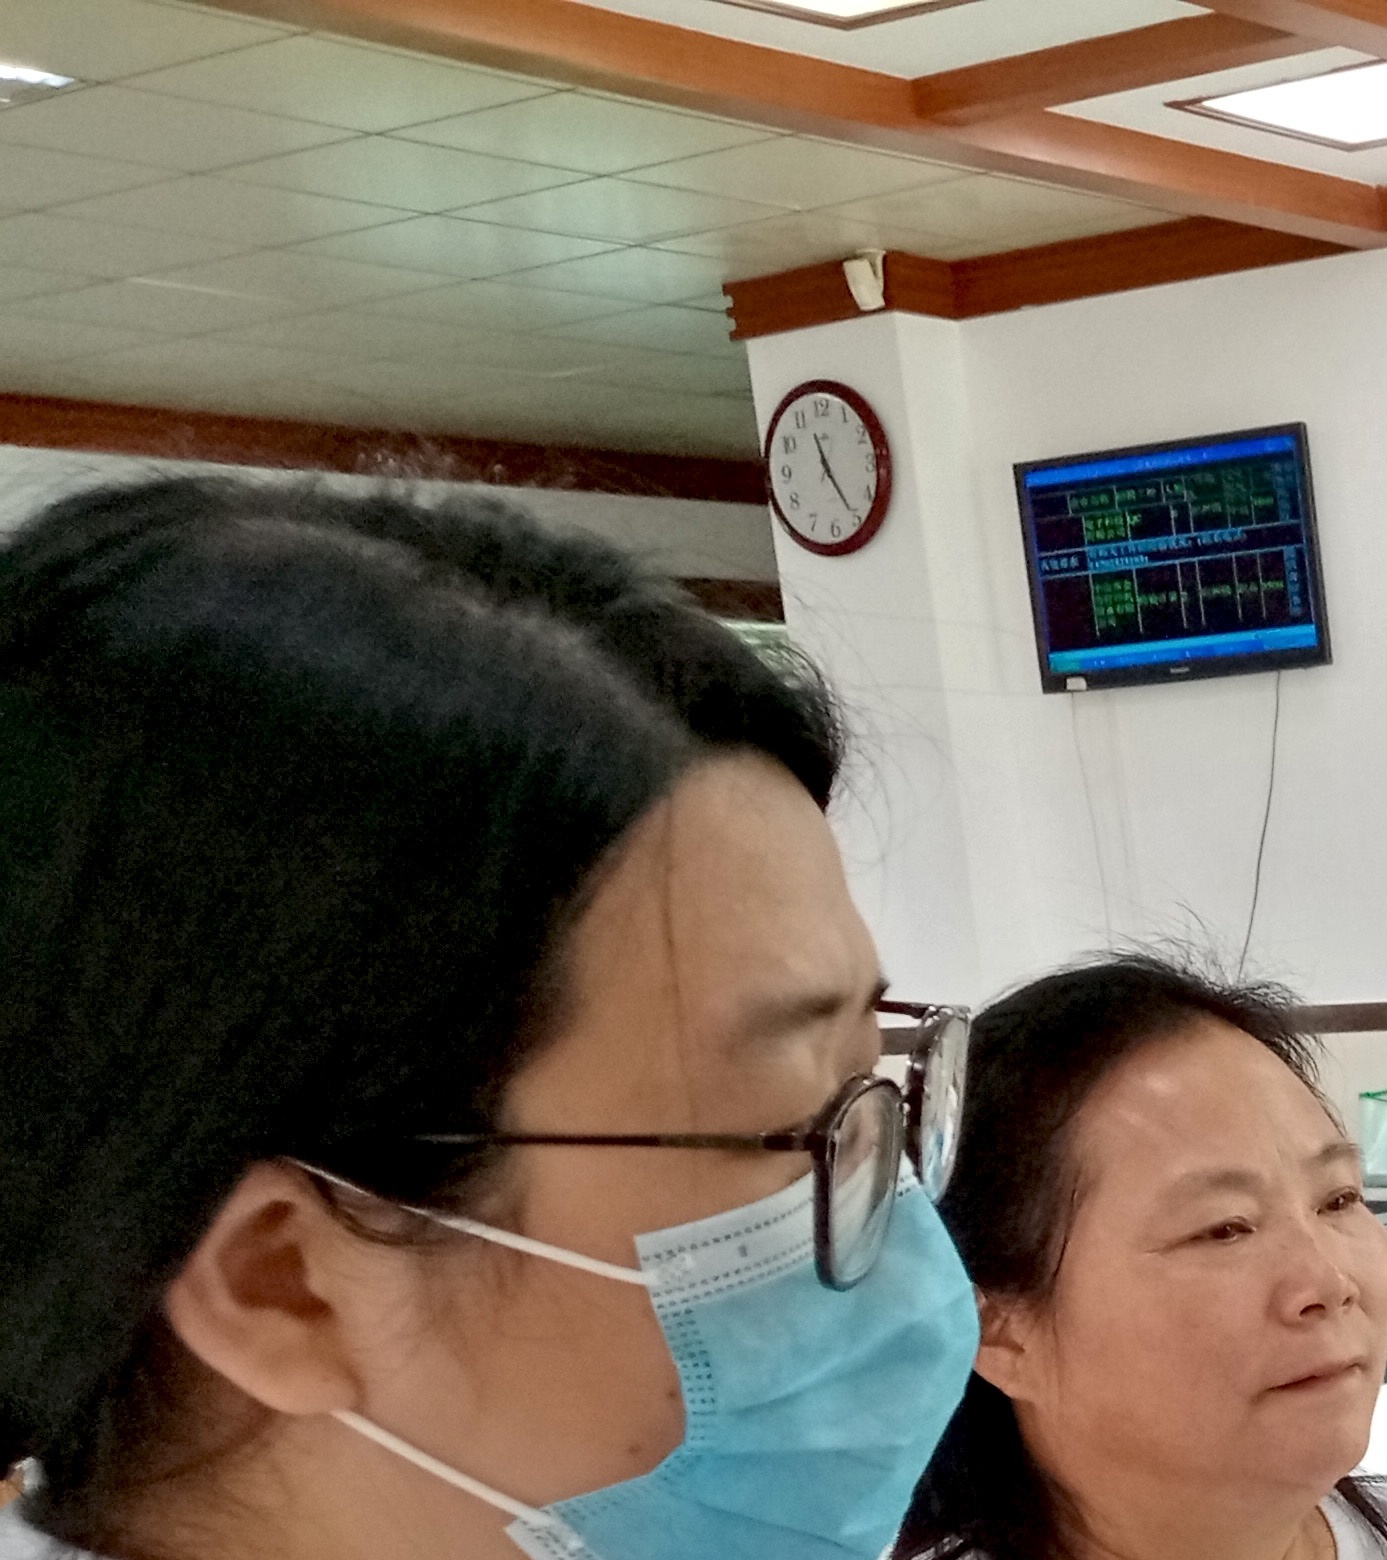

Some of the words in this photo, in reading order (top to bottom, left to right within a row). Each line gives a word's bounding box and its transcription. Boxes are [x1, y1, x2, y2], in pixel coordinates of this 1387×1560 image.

[814, 400, 829, 418] 12
[781, 465, 792, 484] 9
[809, 513, 817, 532] 7
[831, 520, 841, 538] 6
